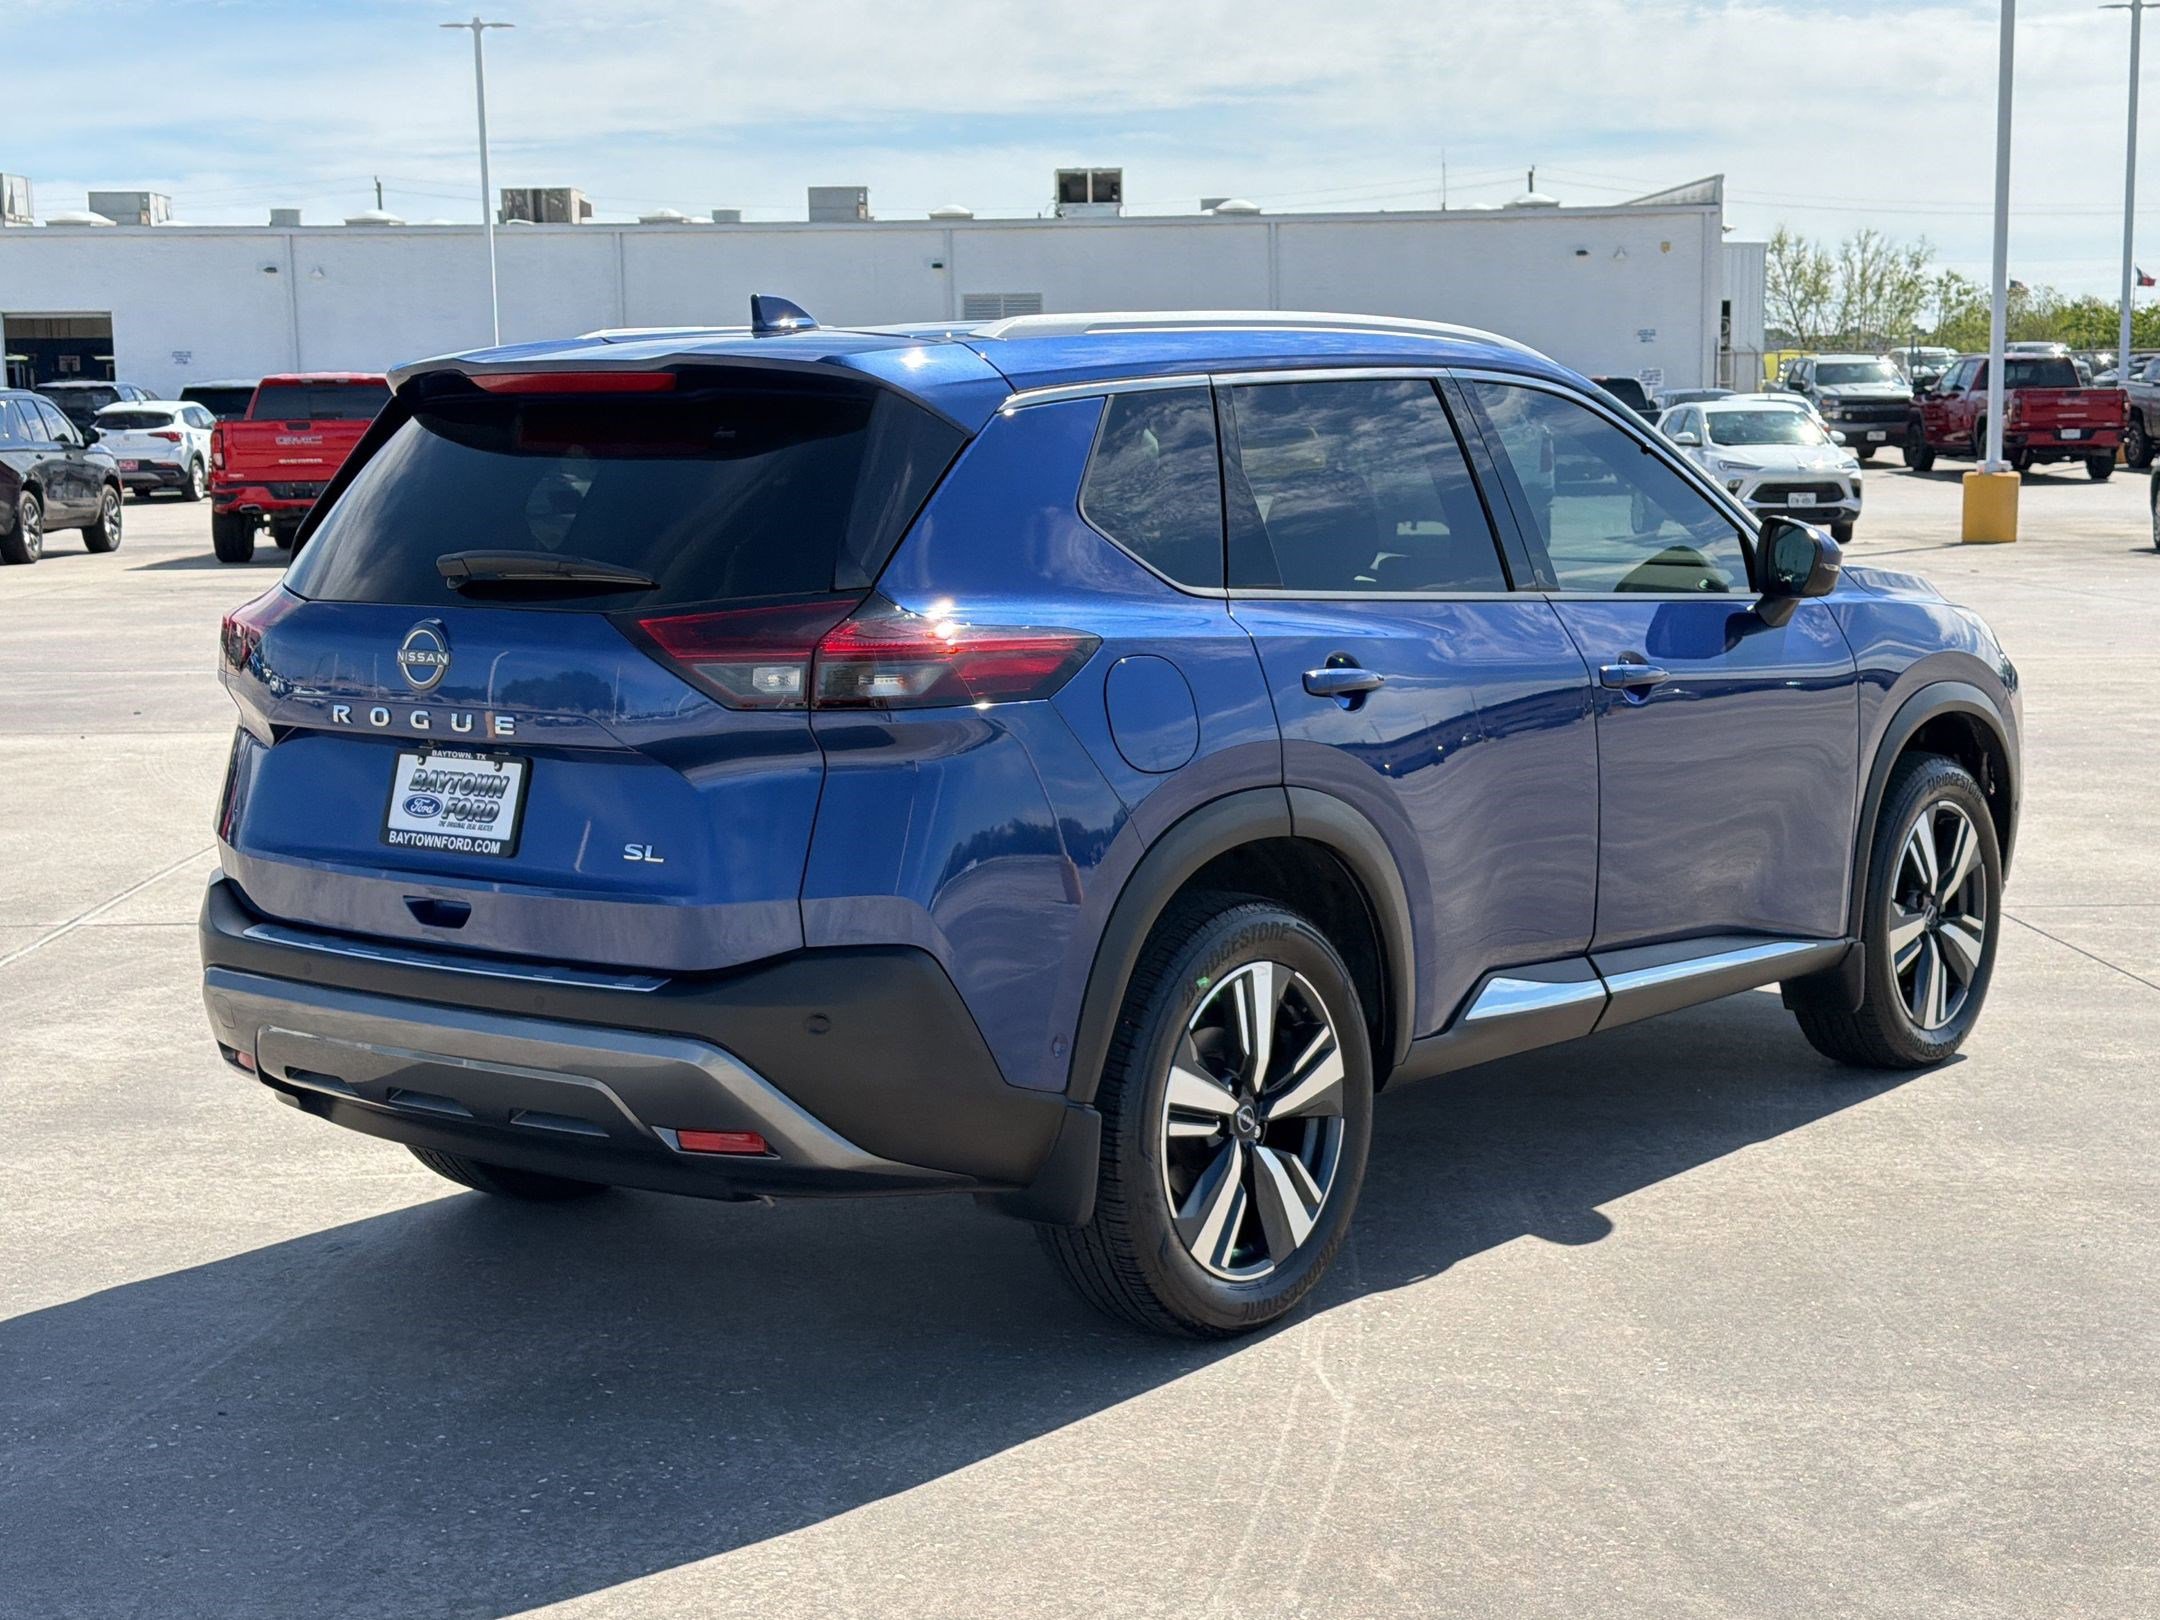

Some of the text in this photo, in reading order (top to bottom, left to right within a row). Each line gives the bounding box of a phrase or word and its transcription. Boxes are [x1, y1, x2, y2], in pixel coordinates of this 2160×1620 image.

[397, 651, 449, 665] NISSAN
[332, 704, 517, 736] ROGUE
[476, 753, 487, 761] TX
[408, 768, 511, 799] BAYTOWN
[410, 798, 436, 815] Ford
[441, 796, 501, 824] FORD
[388, 830, 501, 855] BAYTOWNFORD.COM
[623, 843, 664, 863] SL
